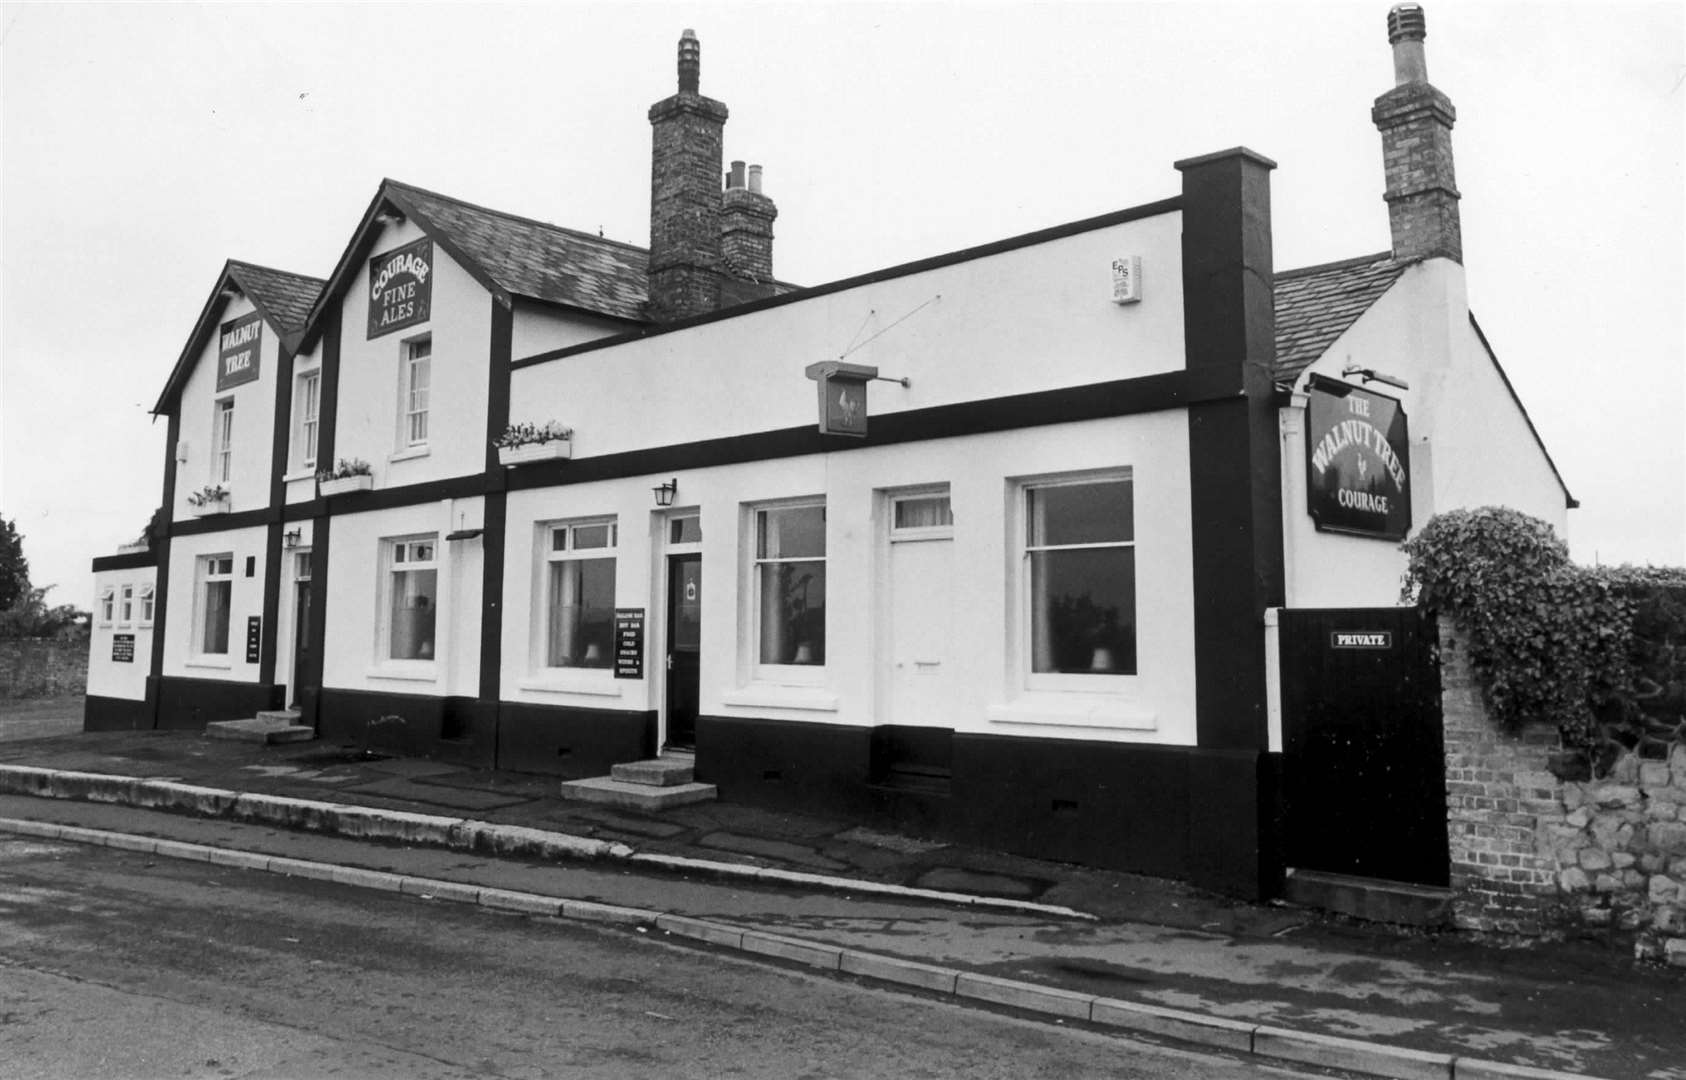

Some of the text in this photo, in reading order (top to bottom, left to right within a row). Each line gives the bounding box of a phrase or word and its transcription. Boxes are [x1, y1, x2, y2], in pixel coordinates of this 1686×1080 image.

[372, 252, 429, 300] COURAGE
[1112, 260, 1129, 277] EPS
[383, 281, 416, 306] FINE
[380, 301, 414, 326] ALES
[222, 320, 261, 352] WALNUT
[225, 350, 252, 376] TREE
[1347, 394, 1370, 417] THE
[1312, 420, 1406, 494] WALNUT TREE
[1338, 488, 1389, 514] COURAGE
[1337, 634, 1385, 646] PRIVATE
